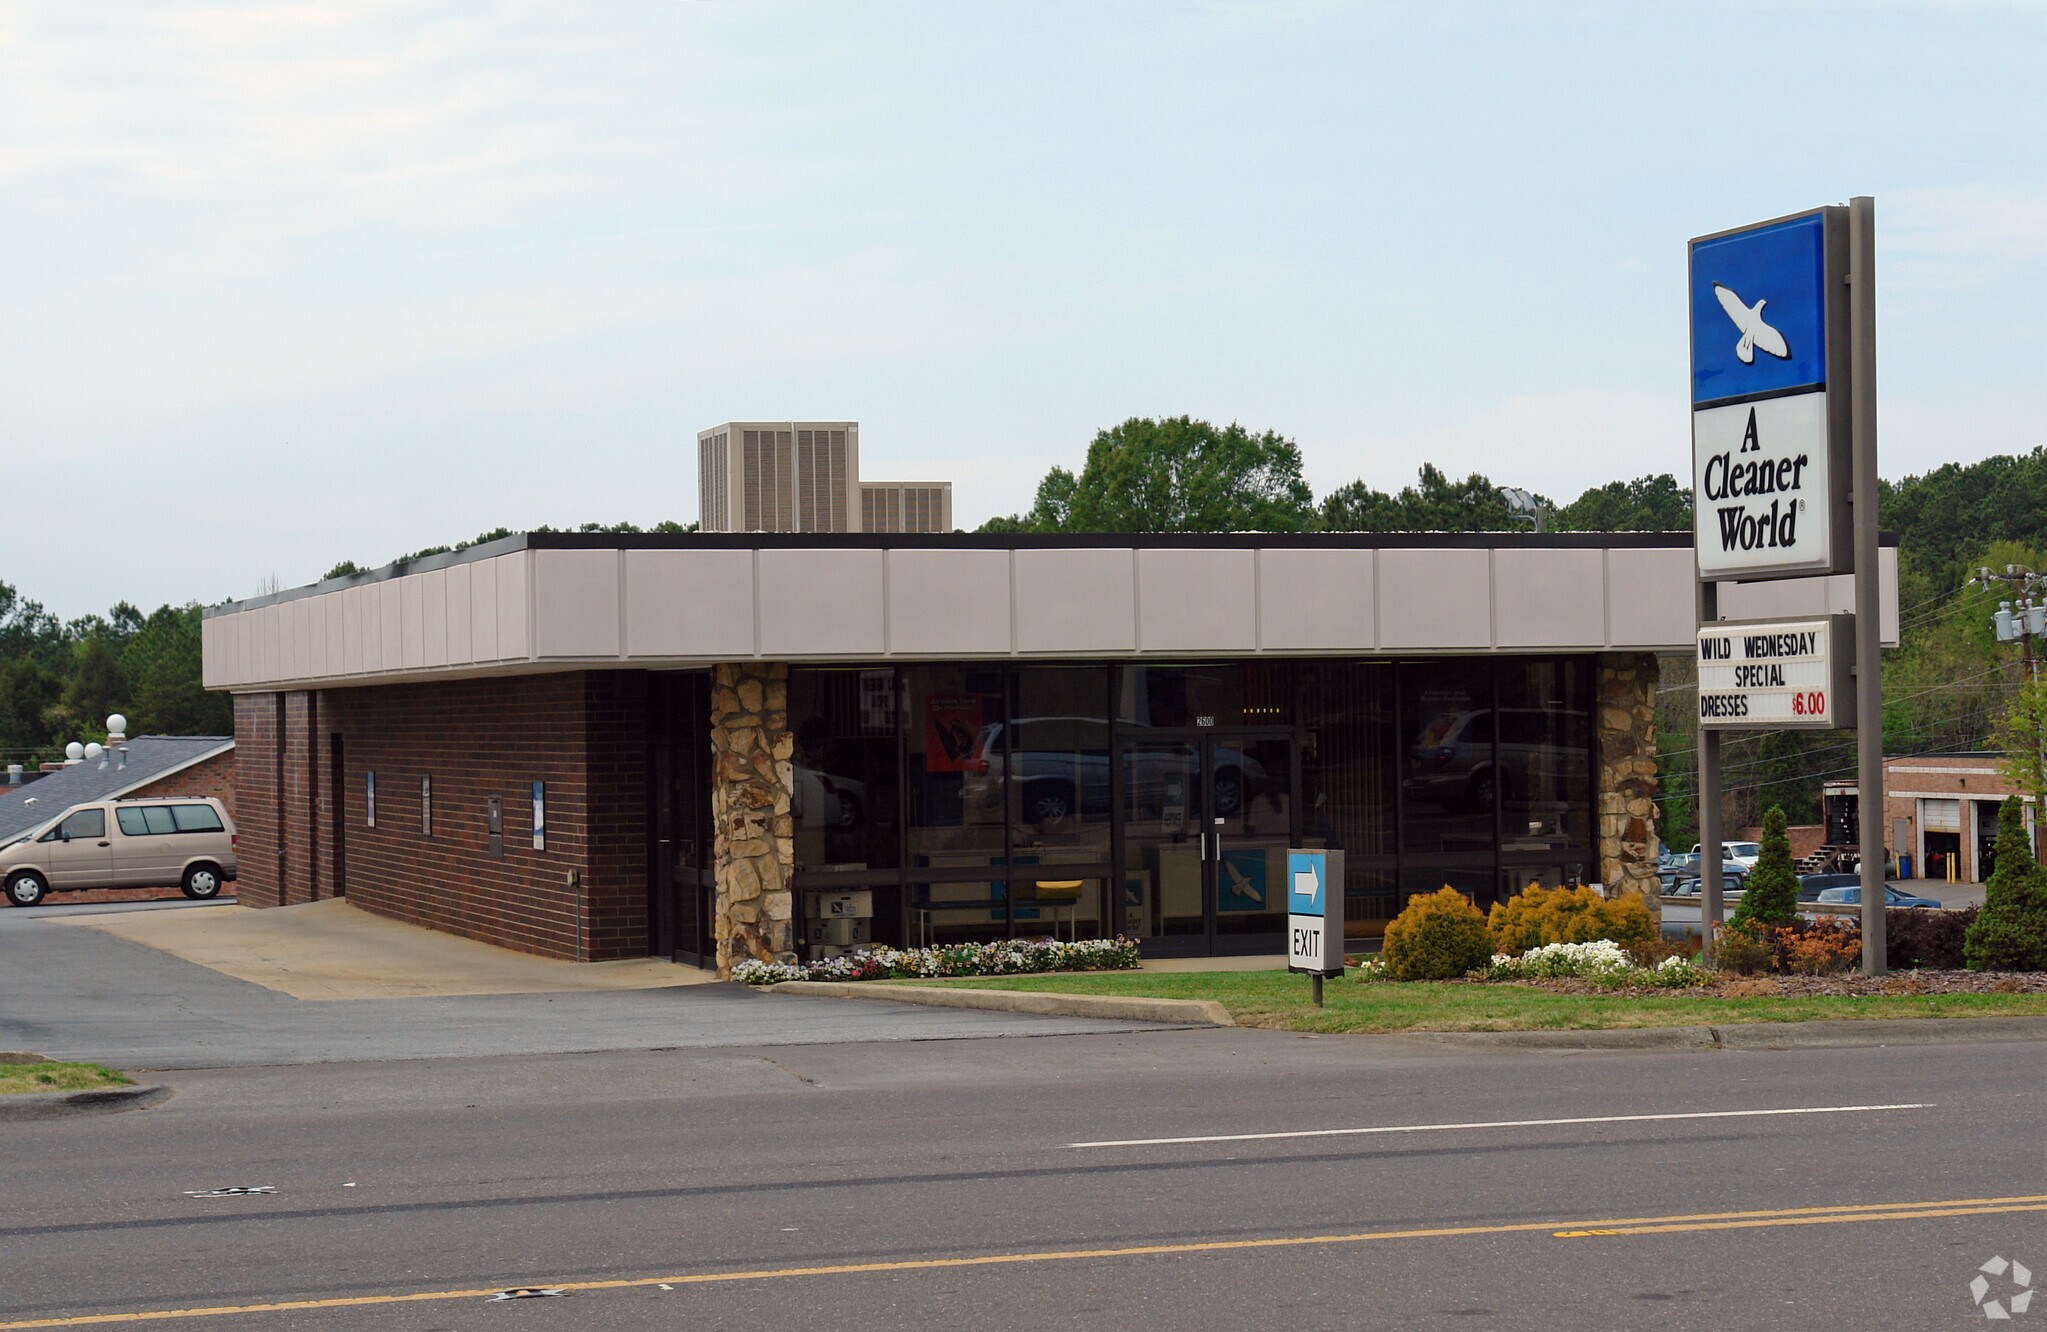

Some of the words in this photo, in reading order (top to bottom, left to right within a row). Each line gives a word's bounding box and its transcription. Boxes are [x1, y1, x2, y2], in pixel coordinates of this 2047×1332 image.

[1740, 406, 1760, 453] A
[1704, 451, 1808, 501] Cleaner
[1717, 498, 1797, 552] World
[1701, 637, 1731, 660] WILD
[1743, 632, 1816, 658] WEDNESDAY
[1735, 664, 1785, 687] SPECIAL
[1701, 694, 1748, 717] DRESSES
[1792, 691, 1825, 715] $6.00
[1196, 716, 1215, 726] 2600
[1293, 928, 1320, 957] EXIT
